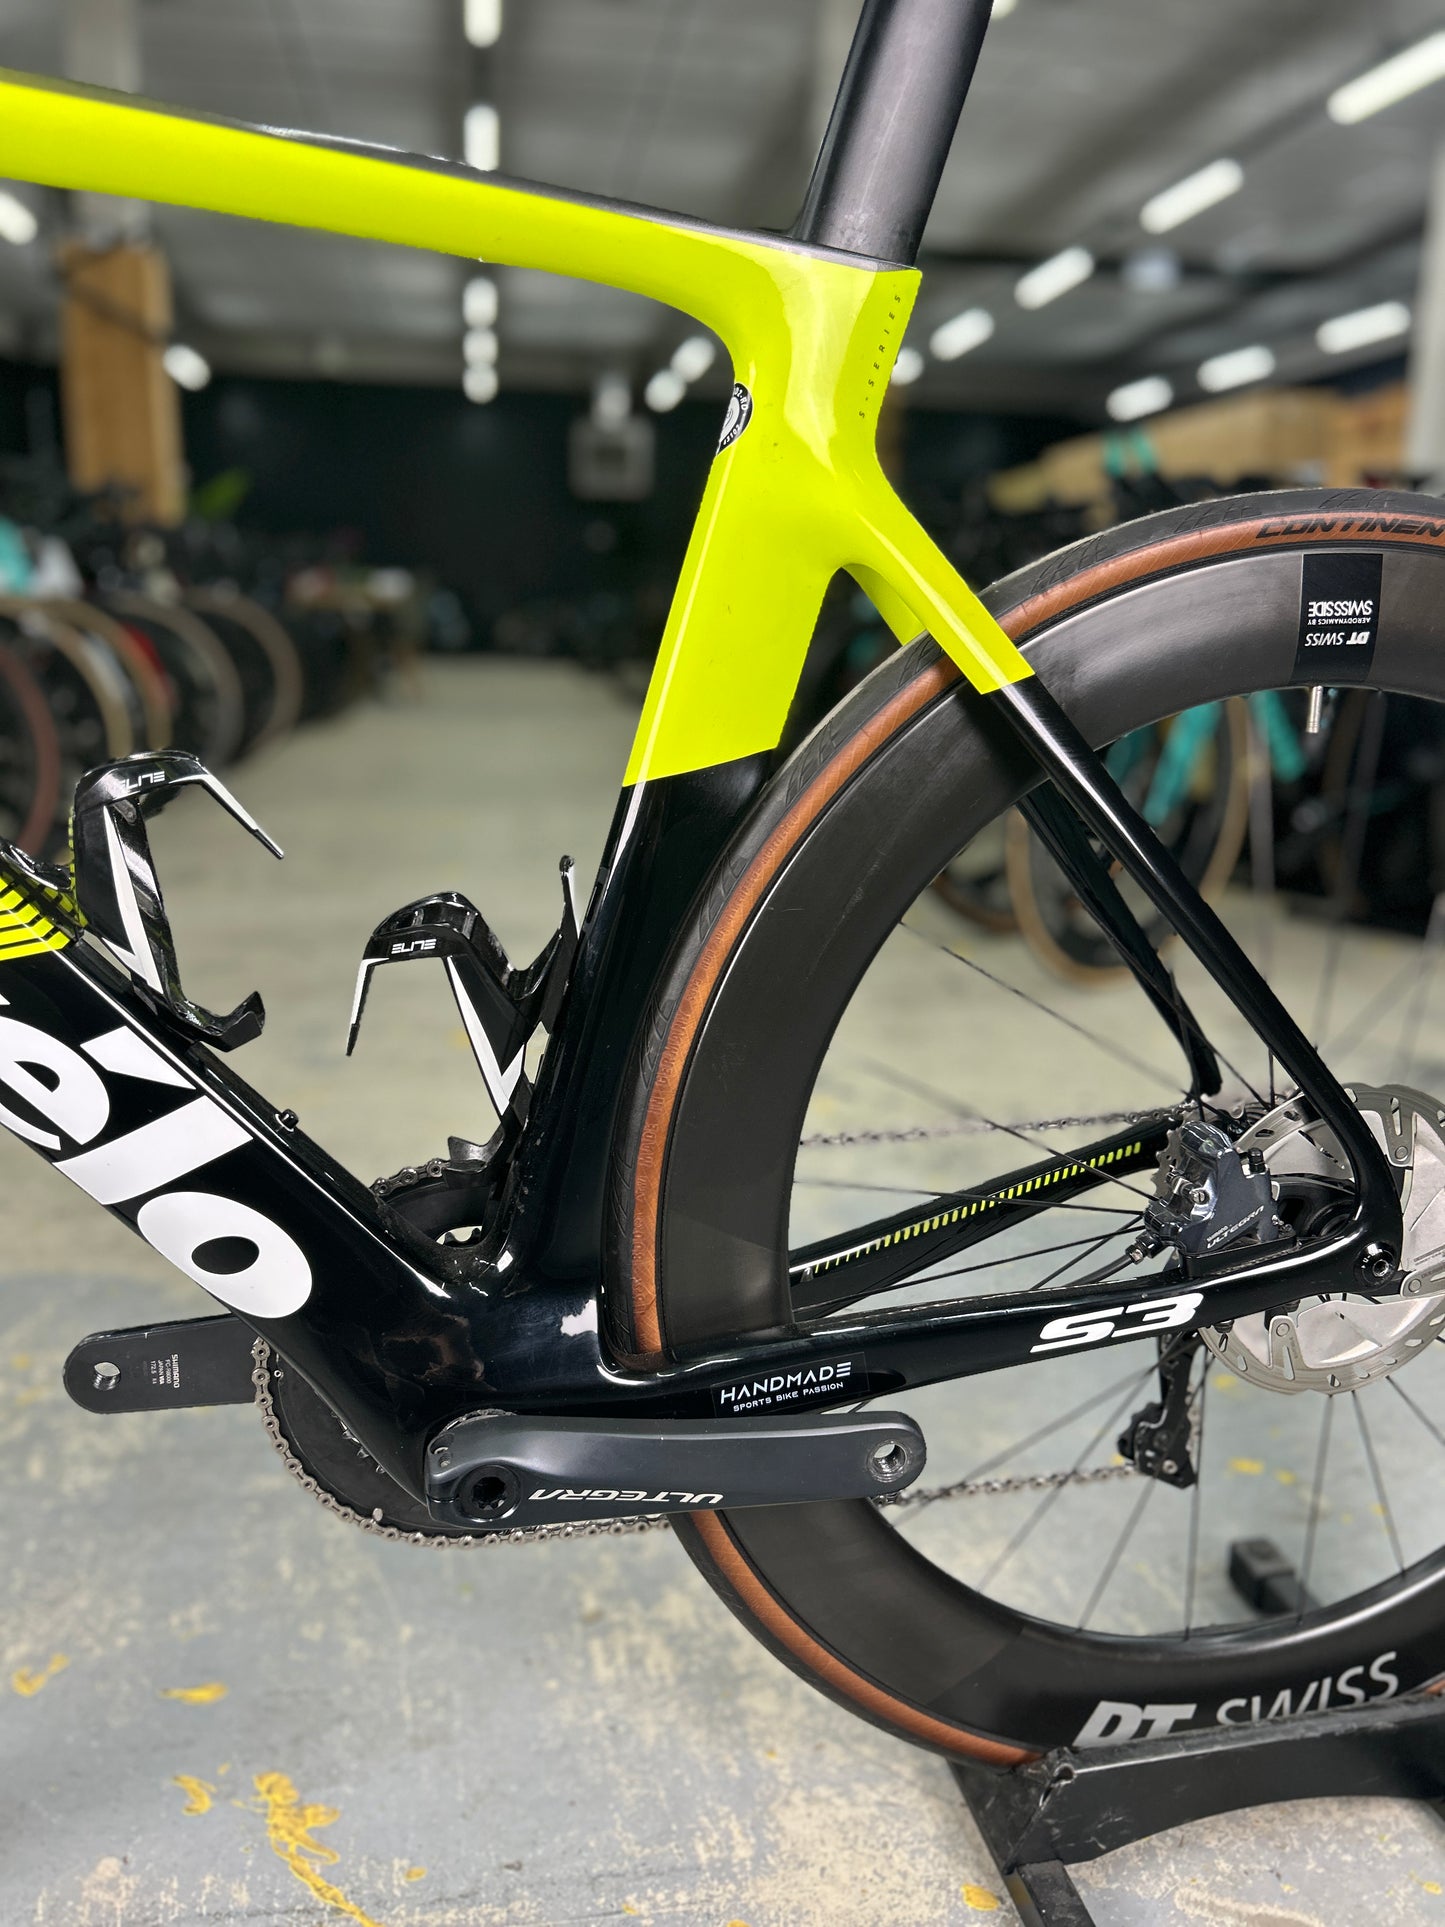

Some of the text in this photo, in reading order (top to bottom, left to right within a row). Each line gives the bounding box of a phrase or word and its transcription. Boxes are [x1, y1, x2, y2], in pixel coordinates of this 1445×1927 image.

[1308, 617, 1371, 626] AERODYNAMICS BY
[1304, 631, 1370, 647] DT SWISS
[391, 939, 437, 954] ELITE
[0, 993, 312, 1319] élo
[1207, 1205, 1264, 1249] ULTEGRA
[1030, 1293, 1204, 1353] S3
[172, 1354, 180, 1388] SHIMANO
[720, 1361, 851, 1404] HANDMADE
[733, 1381, 844, 1412] SPORTS BIKE PASSION
[529, 1488, 723, 1504] ULTEGRA
[1072, 1700, 1197, 1747] DT
